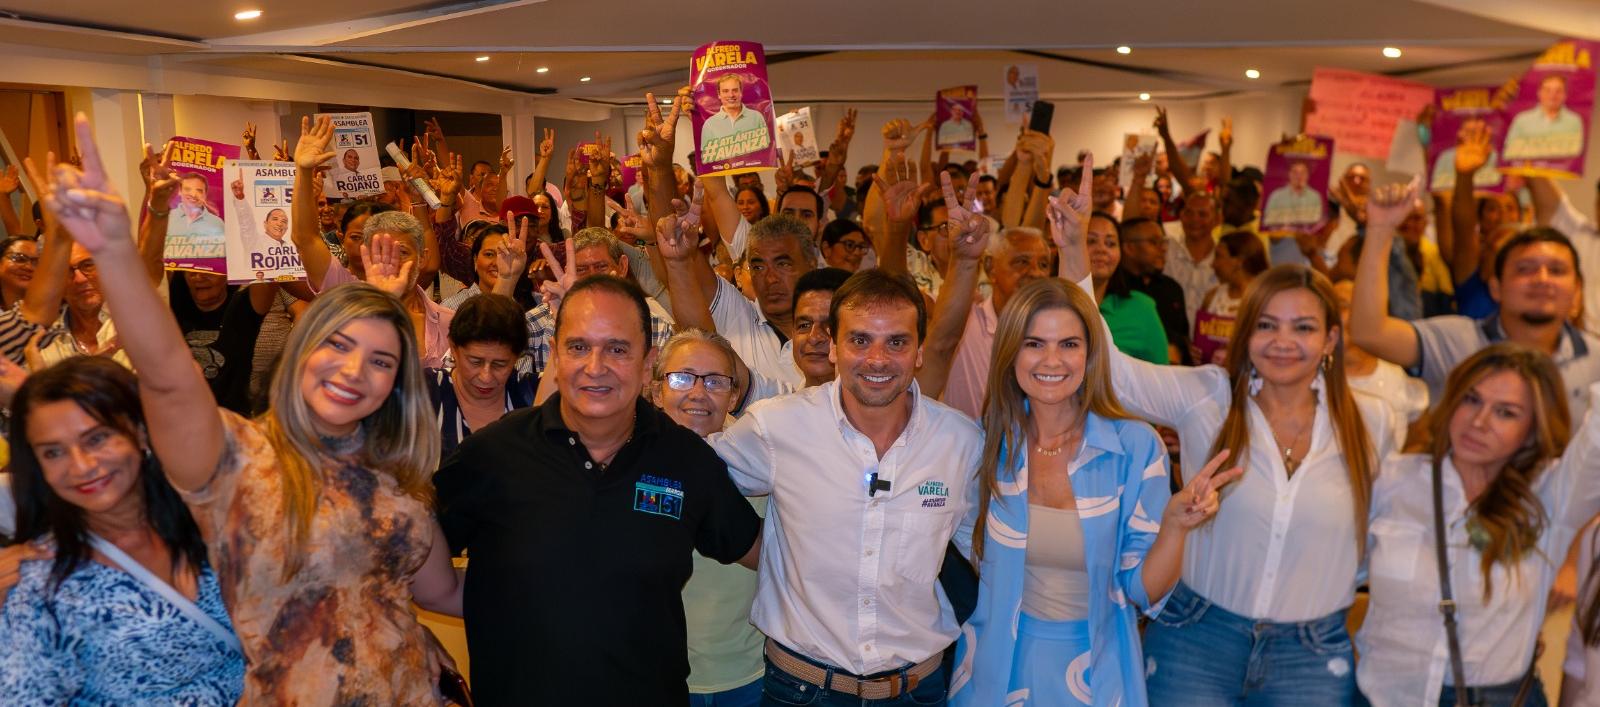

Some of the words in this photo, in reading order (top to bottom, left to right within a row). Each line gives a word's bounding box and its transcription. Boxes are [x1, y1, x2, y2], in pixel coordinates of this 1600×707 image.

[706, 45, 740, 54] ALFREDO
[696, 51, 758, 71] VARELA
[707, 63, 747, 72] GOBERNADOR
[334, 119, 368, 127] ASAMBLEA
[355, 134, 368, 145] 51
[174, 141, 213, 153] ALFREDO
[170, 148, 226, 170] ARELA
[171, 162, 217, 173] GOBERNADOR
[255, 168, 297, 177] ASAMBLE
[347, 174, 378, 182] CARLOS
[336, 180, 380, 191] ROJANO
[285, 188, 294, 203] 5
[268, 246, 298, 256] CARL
[251, 252, 303, 270] ROJAN
[640, 474, 682, 489] ASAMBLEA
[918, 485, 949, 497] VARELA
[663, 496, 679, 515] 51
